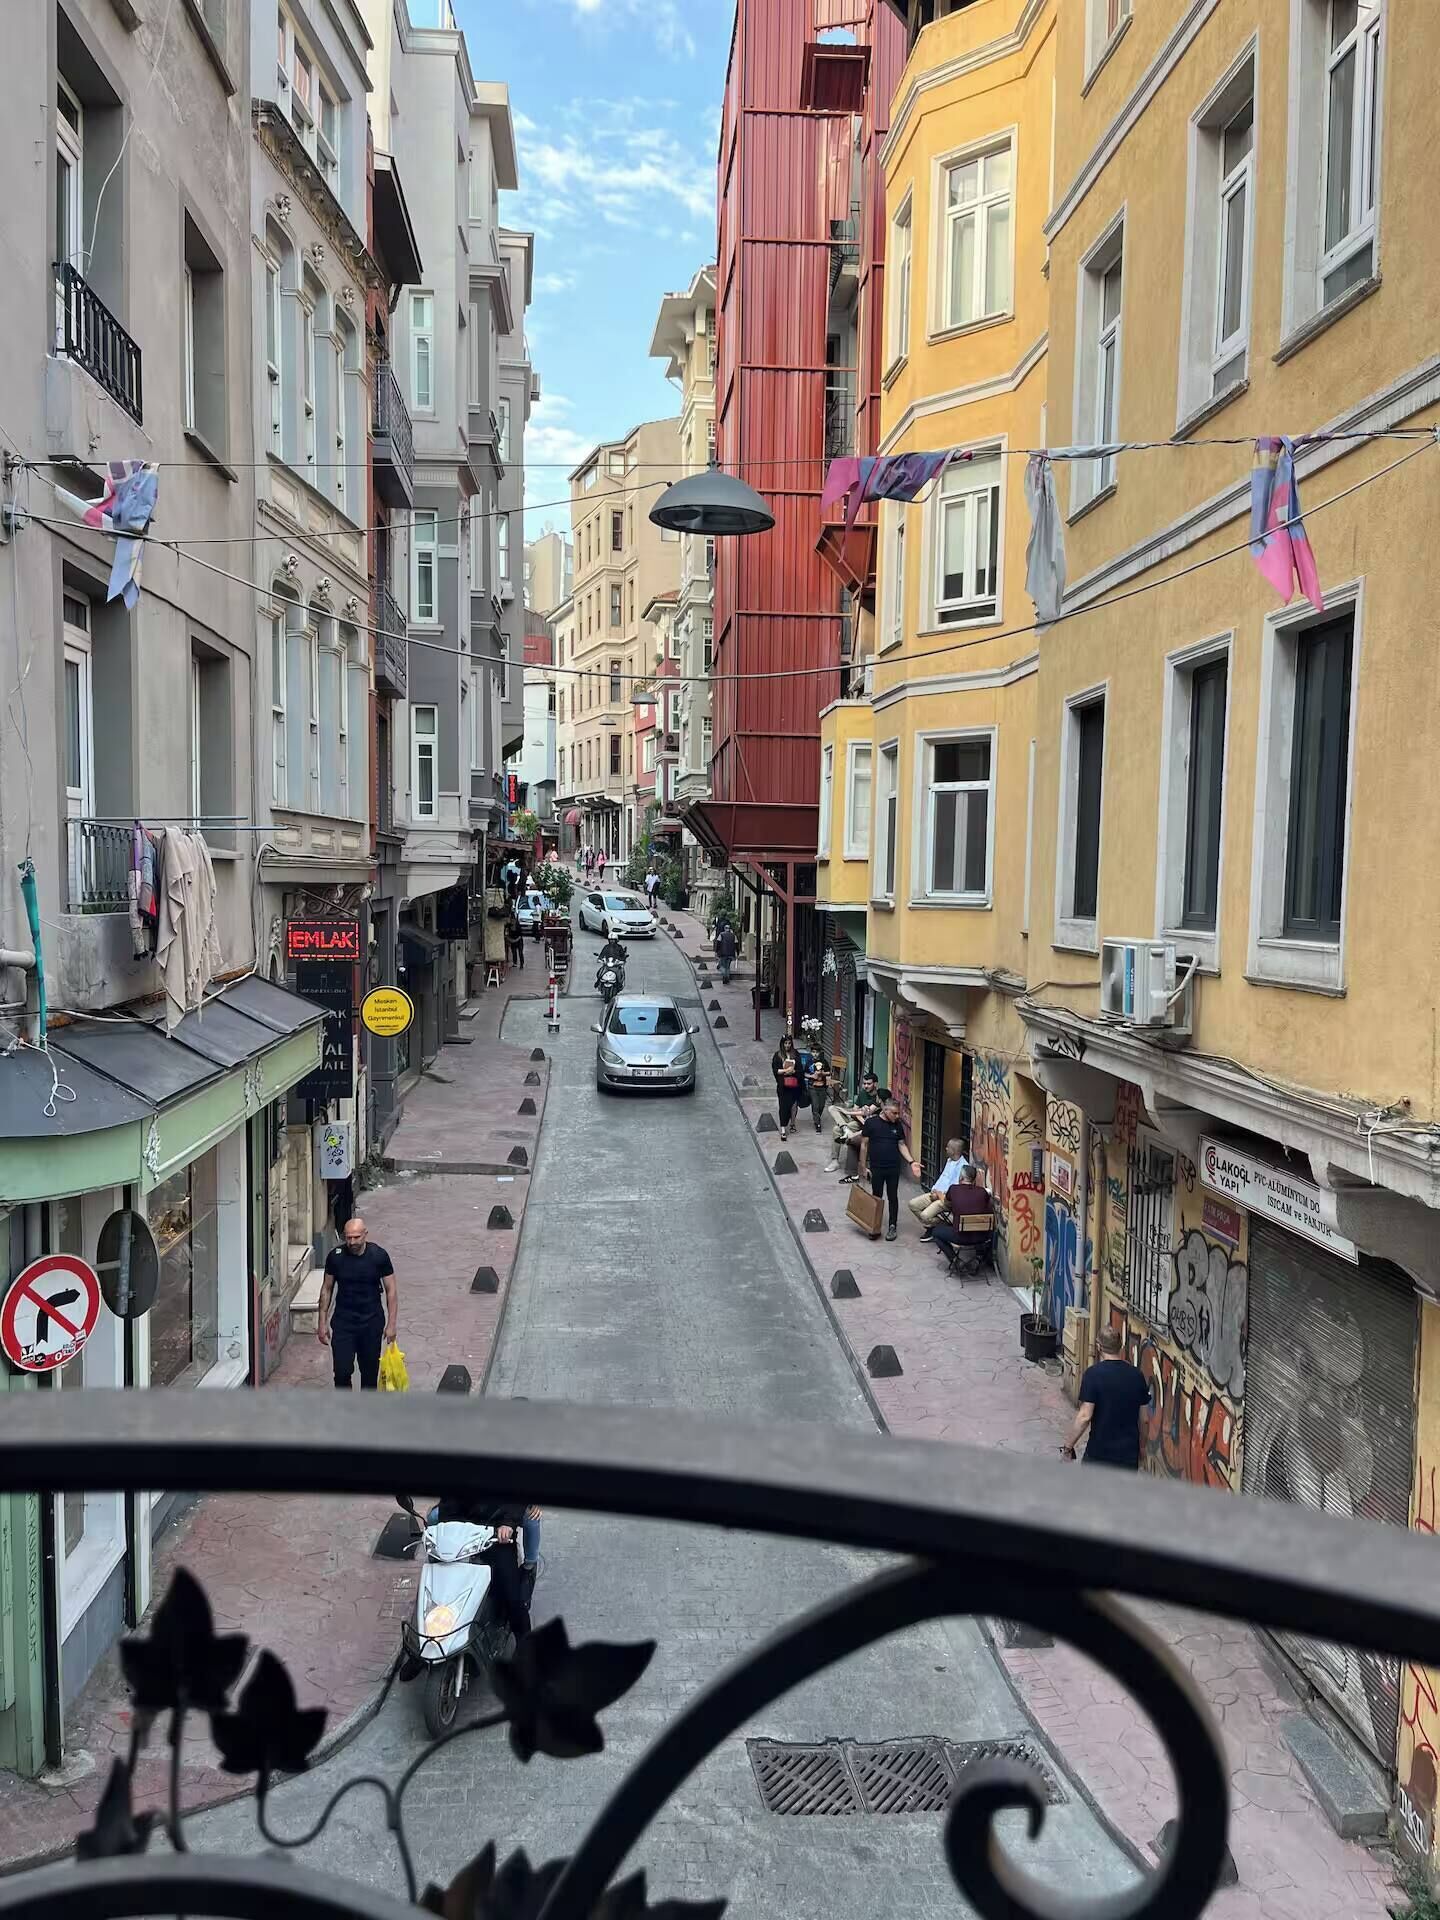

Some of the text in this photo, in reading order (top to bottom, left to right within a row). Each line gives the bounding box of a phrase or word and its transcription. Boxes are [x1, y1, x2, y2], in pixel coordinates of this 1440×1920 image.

[292, 931, 354, 948] EMLAK
[1220, 1174, 1239, 1193] YAPI
[1293, 1210, 1302, 1221] ve
